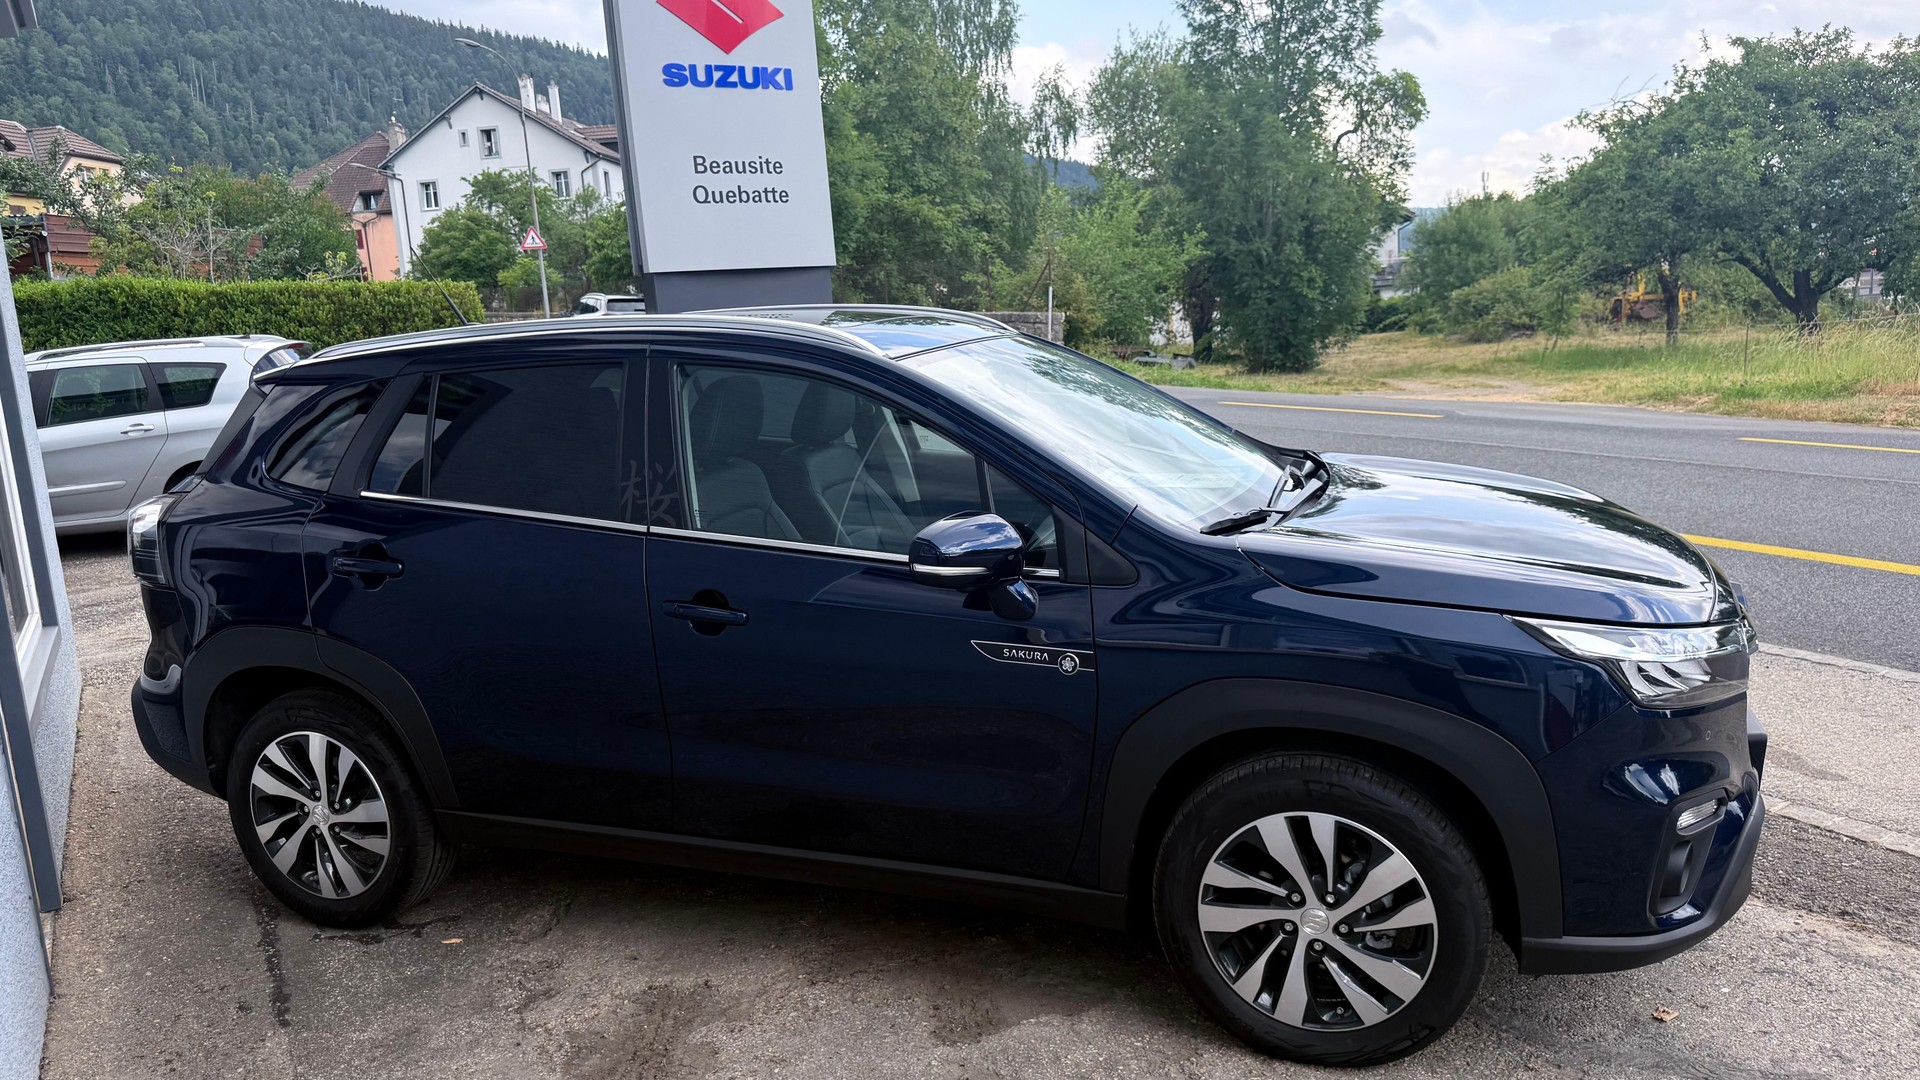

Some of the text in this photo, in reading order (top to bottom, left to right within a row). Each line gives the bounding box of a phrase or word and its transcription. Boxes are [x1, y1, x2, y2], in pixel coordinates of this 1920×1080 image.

[662, 63, 793, 91] SUZUKI
[693, 155, 784, 175] Beausite
[692, 185, 790, 204] Quebatte
[1003, 648, 1049, 662] SAKURA
